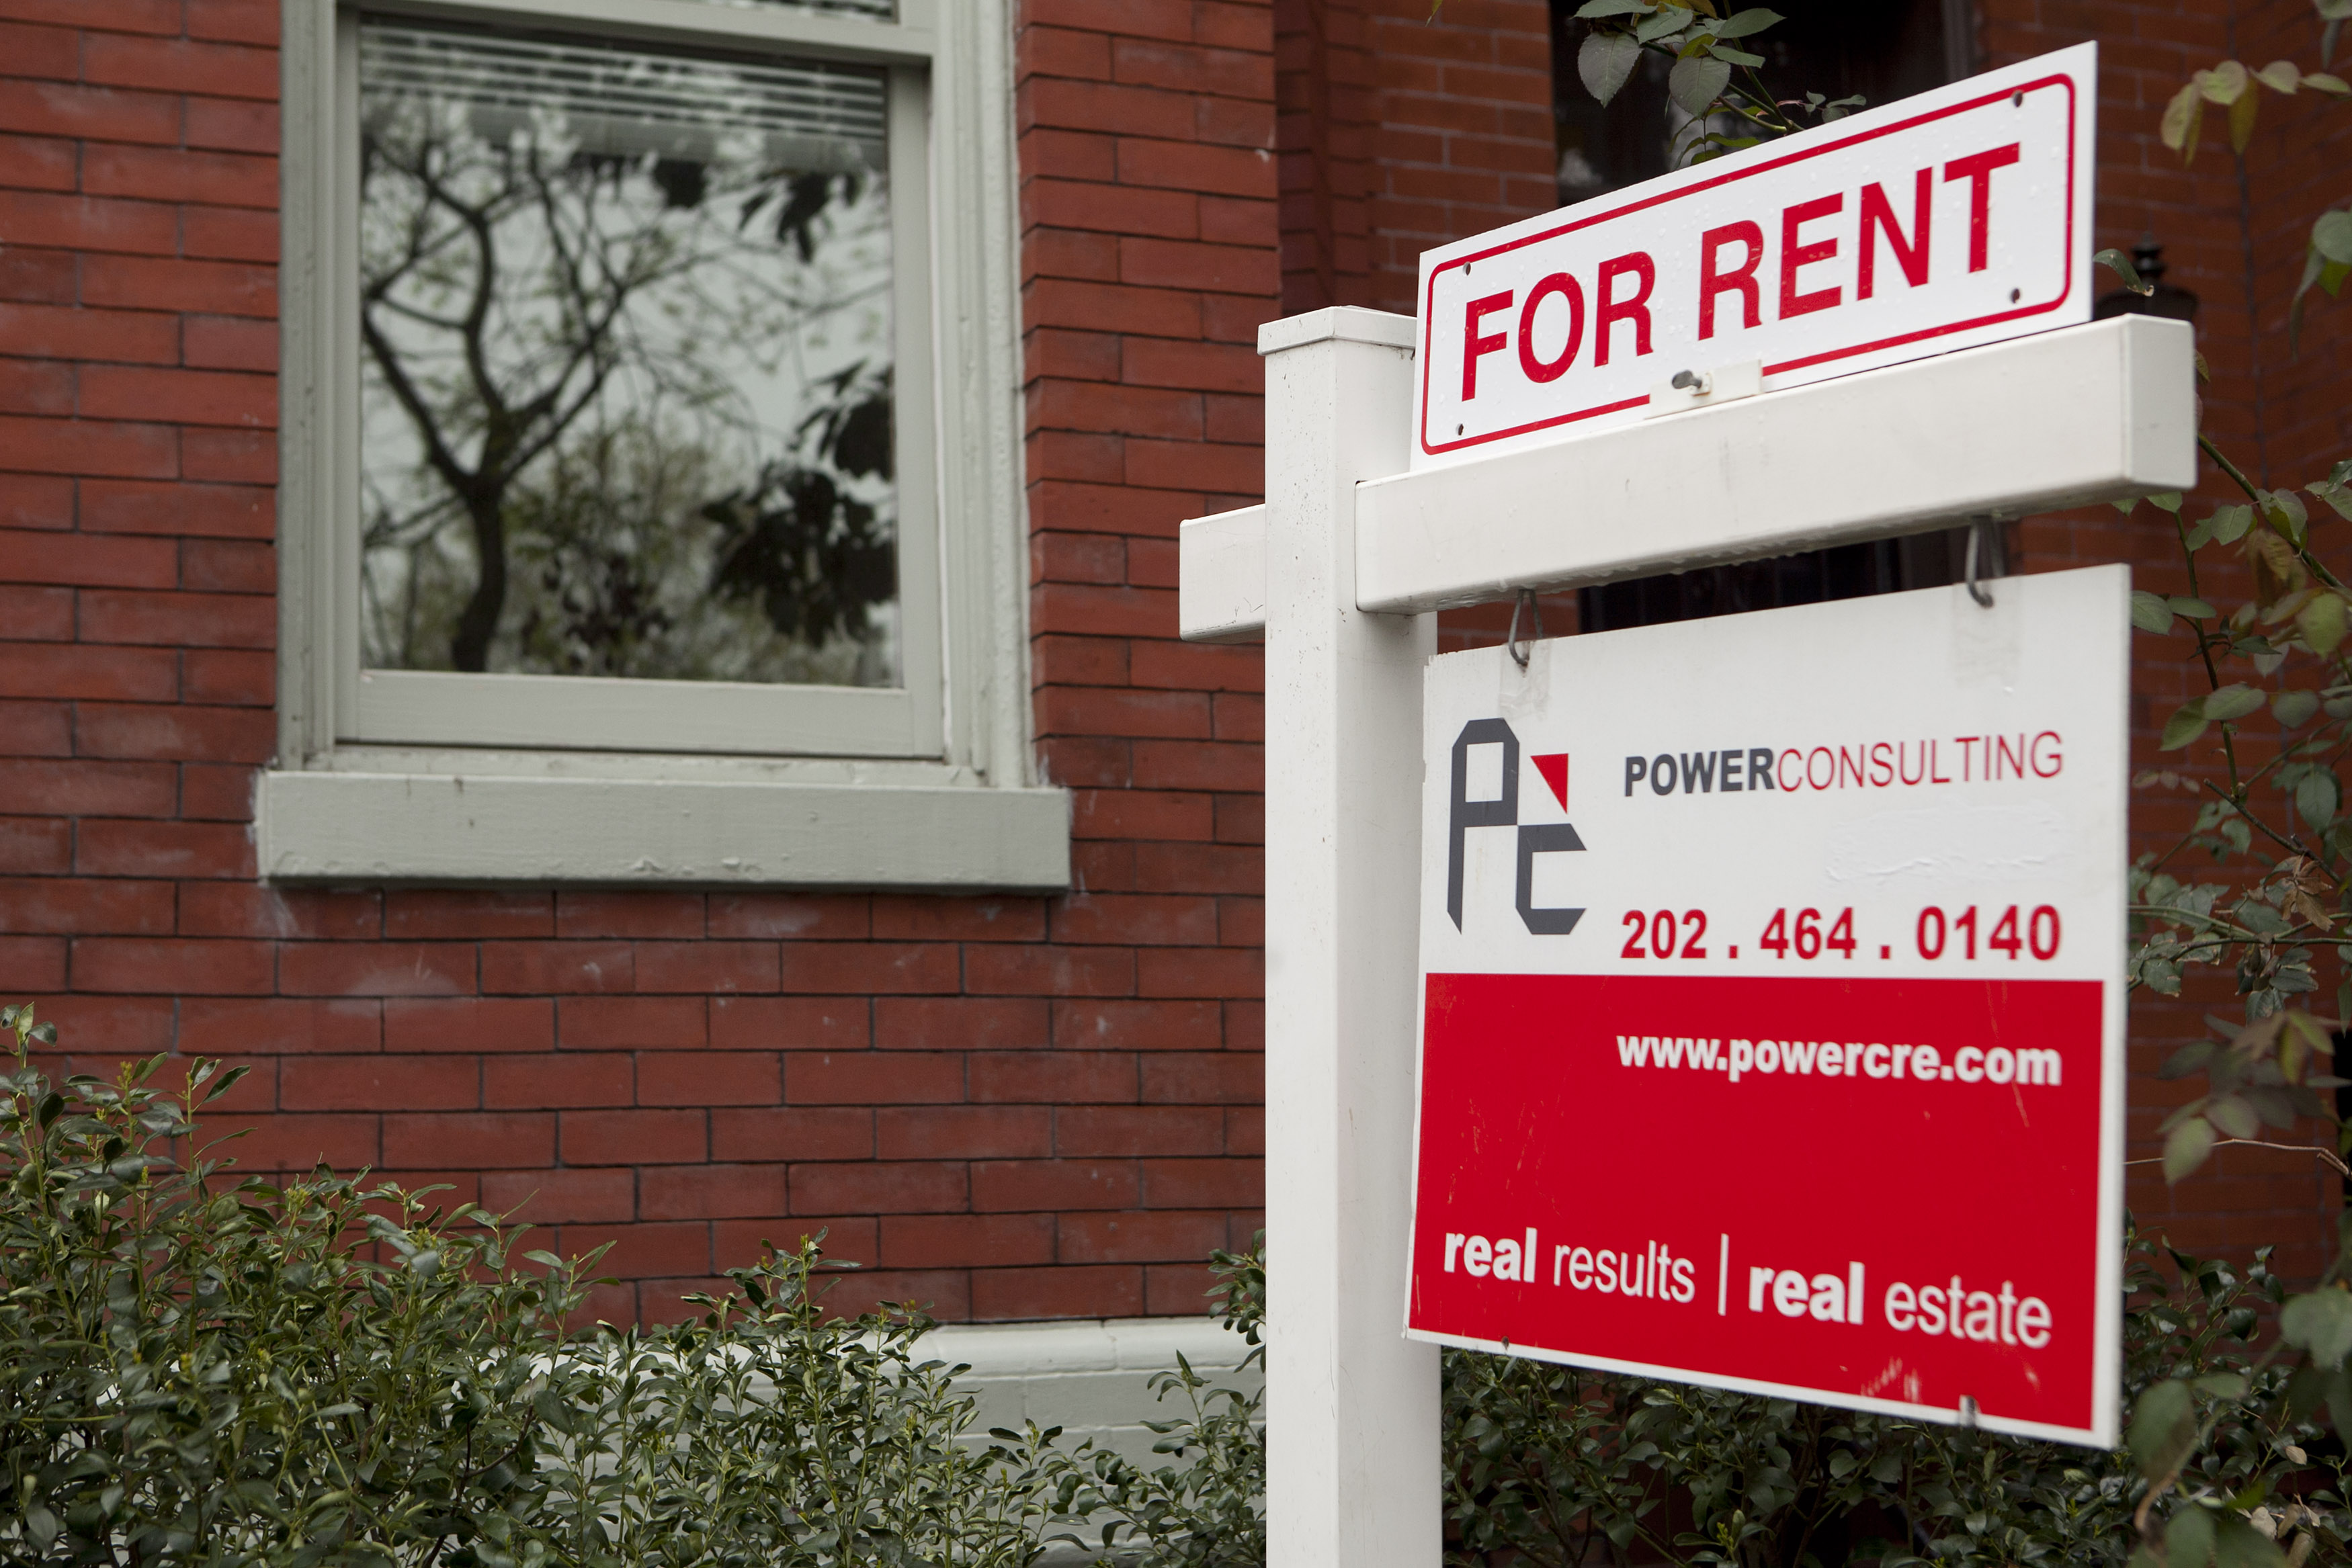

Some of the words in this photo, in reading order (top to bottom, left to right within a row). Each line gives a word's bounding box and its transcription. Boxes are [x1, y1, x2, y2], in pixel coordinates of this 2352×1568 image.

[1462, 251, 1655, 401] FOR
[1699, 142, 2019, 341] RENT
[1626, 731, 2062, 796] POWERCONSULTING
[1617, 1036, 2061, 1085] www.powercre.com
[1444, 1227, 1537, 1282] real
[1554, 1240, 1695, 1303] results
[1749, 1262, 1864, 1324] real
[1885, 1276, 2051, 1348] estate
